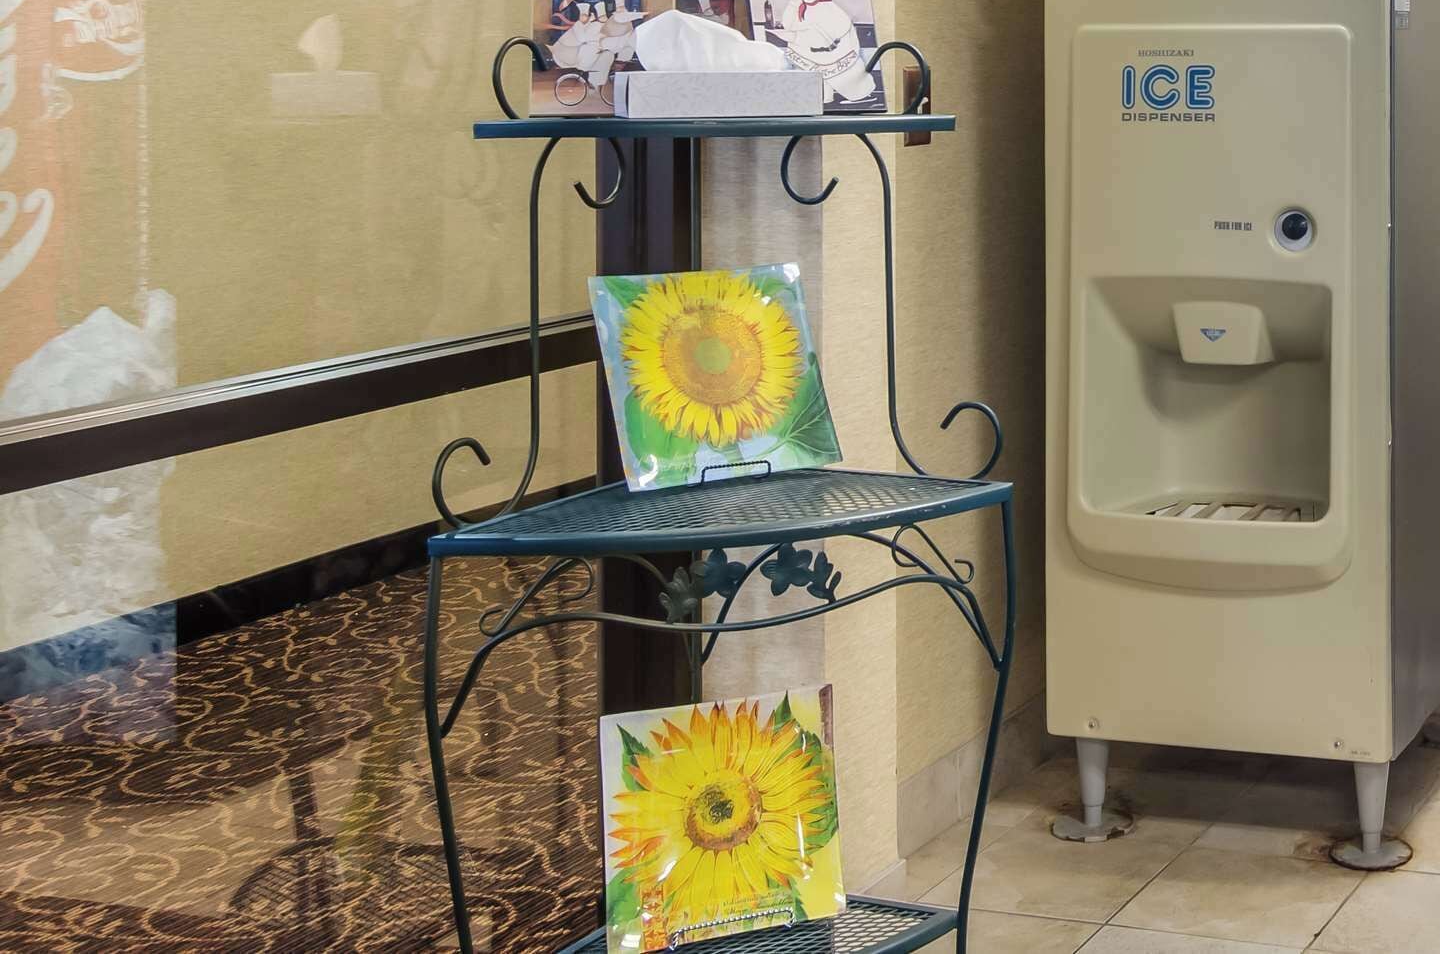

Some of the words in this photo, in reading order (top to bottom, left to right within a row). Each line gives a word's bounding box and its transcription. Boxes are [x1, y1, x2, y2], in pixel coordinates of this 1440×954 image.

[1137, 49, 1195, 57] HOSHIZAKI
[1121, 64, 1216, 111] ICE
[1121, 112, 1216, 122] DISPENSER
